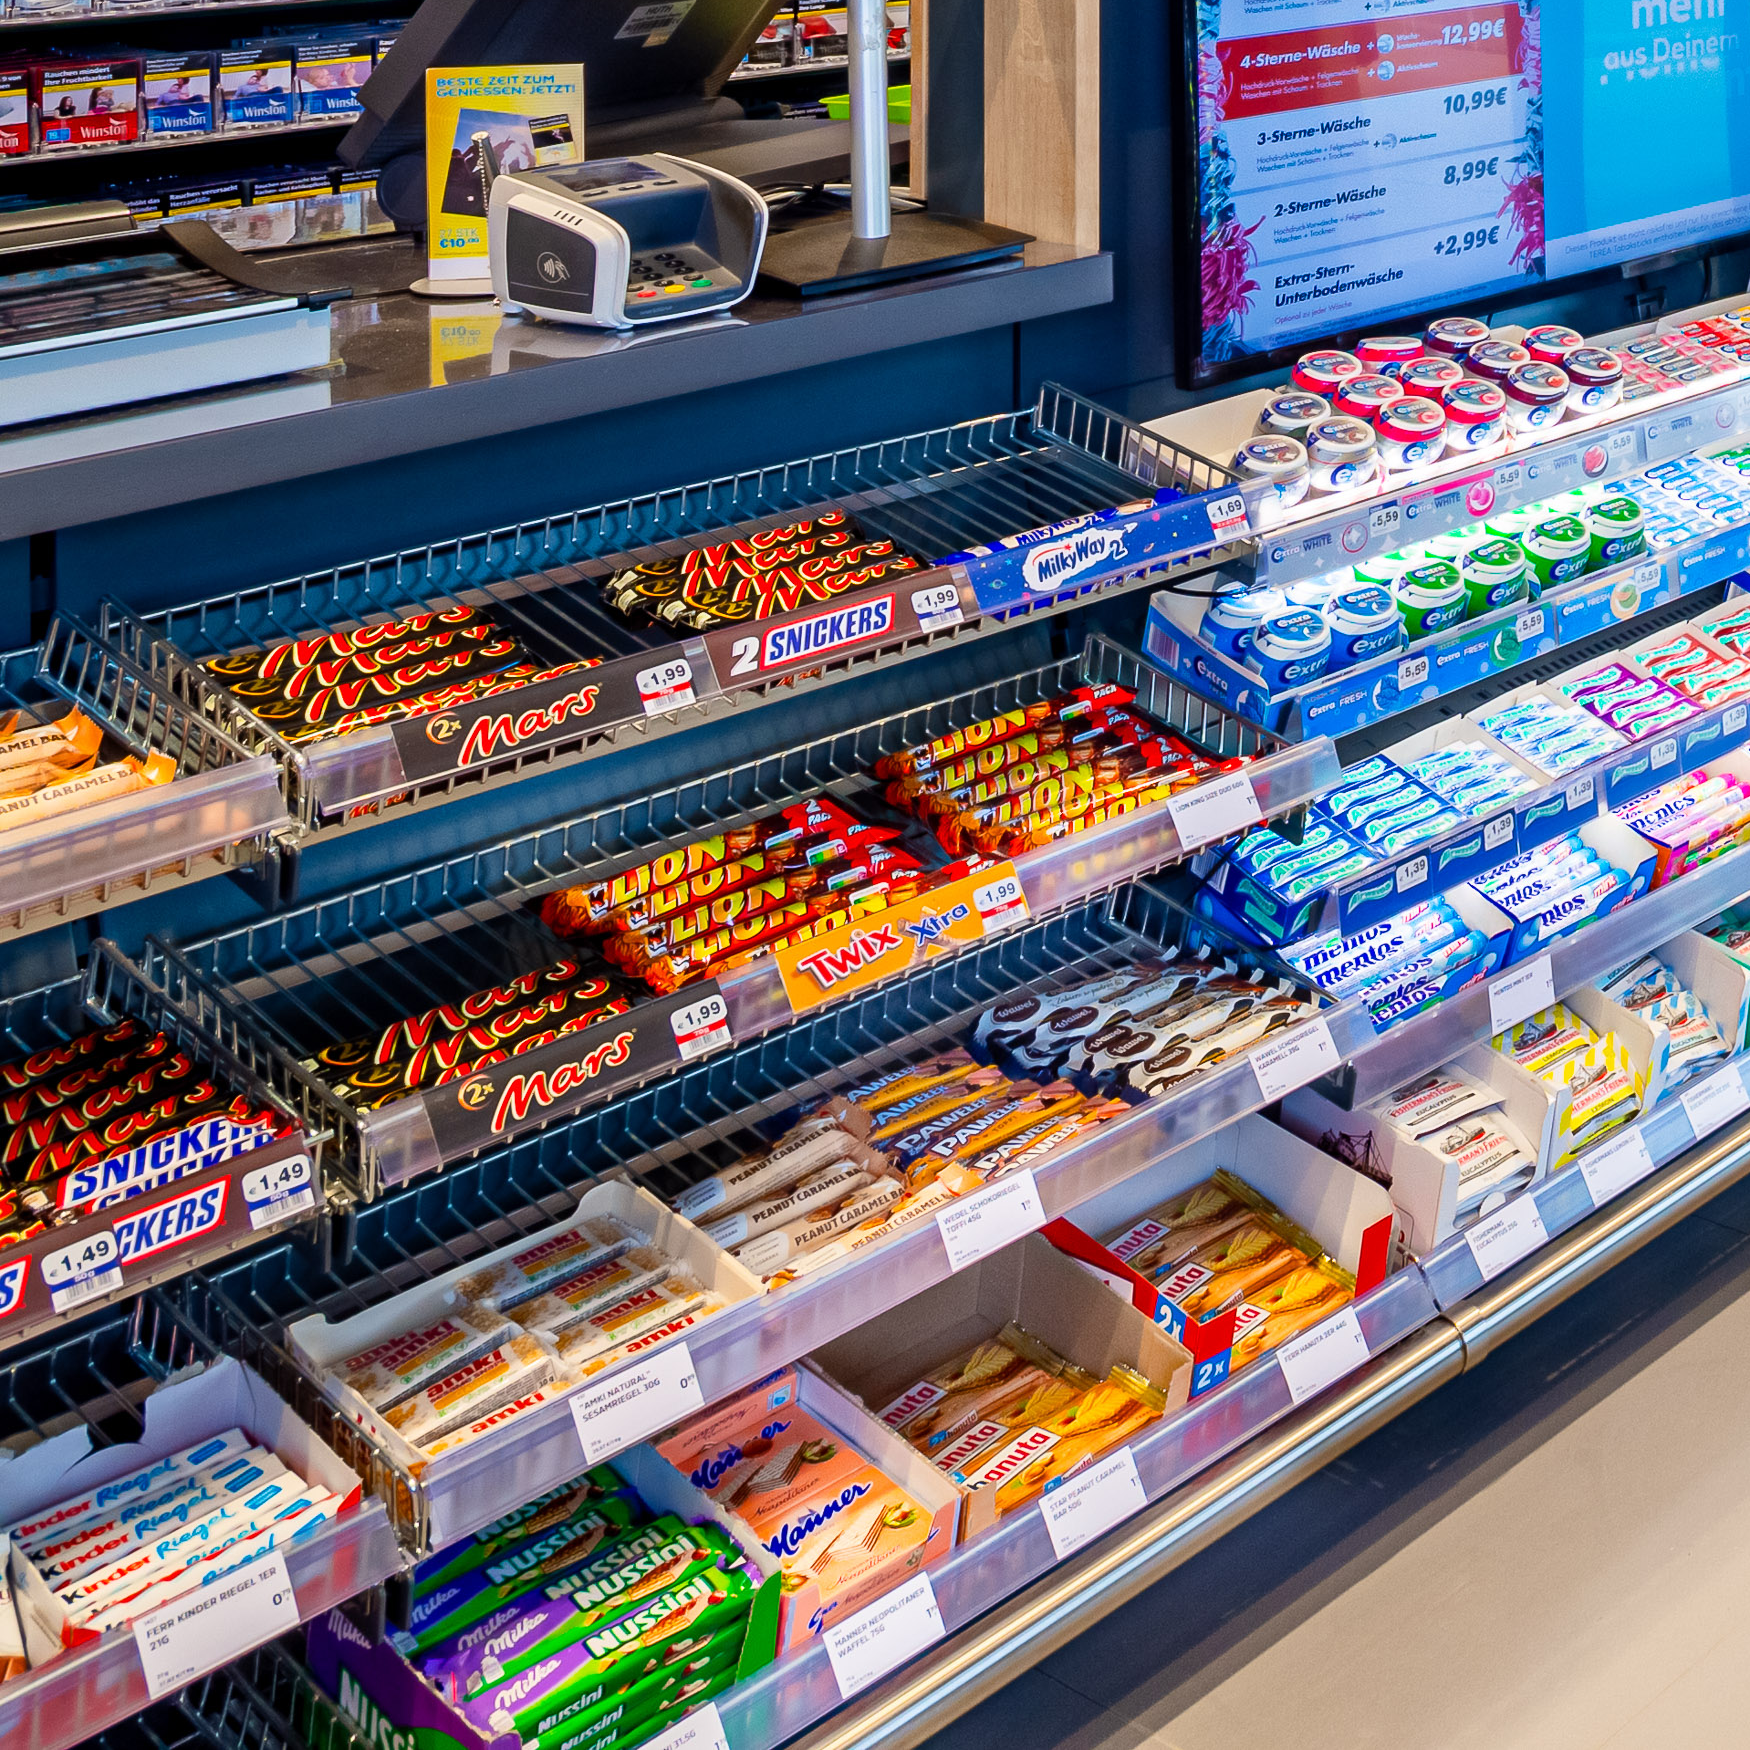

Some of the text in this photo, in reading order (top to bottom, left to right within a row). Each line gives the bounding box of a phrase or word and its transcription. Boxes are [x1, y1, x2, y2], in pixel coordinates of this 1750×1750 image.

[1441, 18, 1506, 46] 12,99€
[1240, 41, 1361, 69] 4-Sterne-Wäsche
[1603, 33, 1738, 71] aus Deinem
[436, 74, 555, 89] BESTE ZEIT ZUM
[436, 84, 576, 98] GENIESSEN: JETZT!
[1443, 87, 1507, 115] 10,99€
[243, 102, 287, 119] Winston
[80, 122, 128, 139] Winston
[1257, 116, 1372, 146] 3-Sterne-Wäsche
[1444, 157, 1499, 186] 8,99€
[1274, 185, 1387, 218] 2-Sterne-Wäsche
[1434, 226, 1500, 256] +2,99€
[1274, 262, 1355, 289] Extra-Stern-
[1275, 268, 1404, 308] Unterbodenwäsche
[1036, 532, 1107, 585] MilkyWay
[1271, 534, 1333, 563] extra WHITE
[258, 604, 476, 679] Mars
[729, 599, 892, 676] 2 SNICKERS
[1437, 641, 1489, 667] extra FRESH
[1283, 654, 1329, 680] extra
[457, 682, 601, 768] Mars
[931, 709, 1027, 761] LION
[608, 834, 727, 907] LION
[907, 903, 969, 947] Xtra
[797, 923, 902, 989] Twix
[1316, 935, 1404, 987] mentos
[374, 959, 581, 1065] Mars
[998, 1001, 1036, 1020] Wawel
[1151, 1049, 1186, 1071] Wawel
[1541, 1048, 1566, 1062] LEMON
[490, 1030, 635, 1135] Mars
[1416, 1094, 1457, 1116] EUCALYPTUS
[729, 1132, 822, 1186] PEANUT CARAMEL
[794, 1196, 888, 1247] PEANUT CARAMEL
[943, 1183, 1021, 1227] WEDEL SCHOKORIEGEL
[626, 1315, 695, 1353] amki
[427, 1349, 502, 1399] amki
[582, 1387, 642, 1423] SESAMRIEGEL
[965, 1429, 1049, 1491] hanuta
[761, 1481, 873, 1559] Manner
[61, 1508, 236, 1605] kinder Riegel
[146, 1621, 175, 1640] FERR
[177, 1598, 217, 1623] KINDER
[219, 1579, 257, 1605] RIEGEL
[835, 1586, 925, 1648] MANNER NEOPOLITANER
[494, 1659, 562, 1711] Milka
